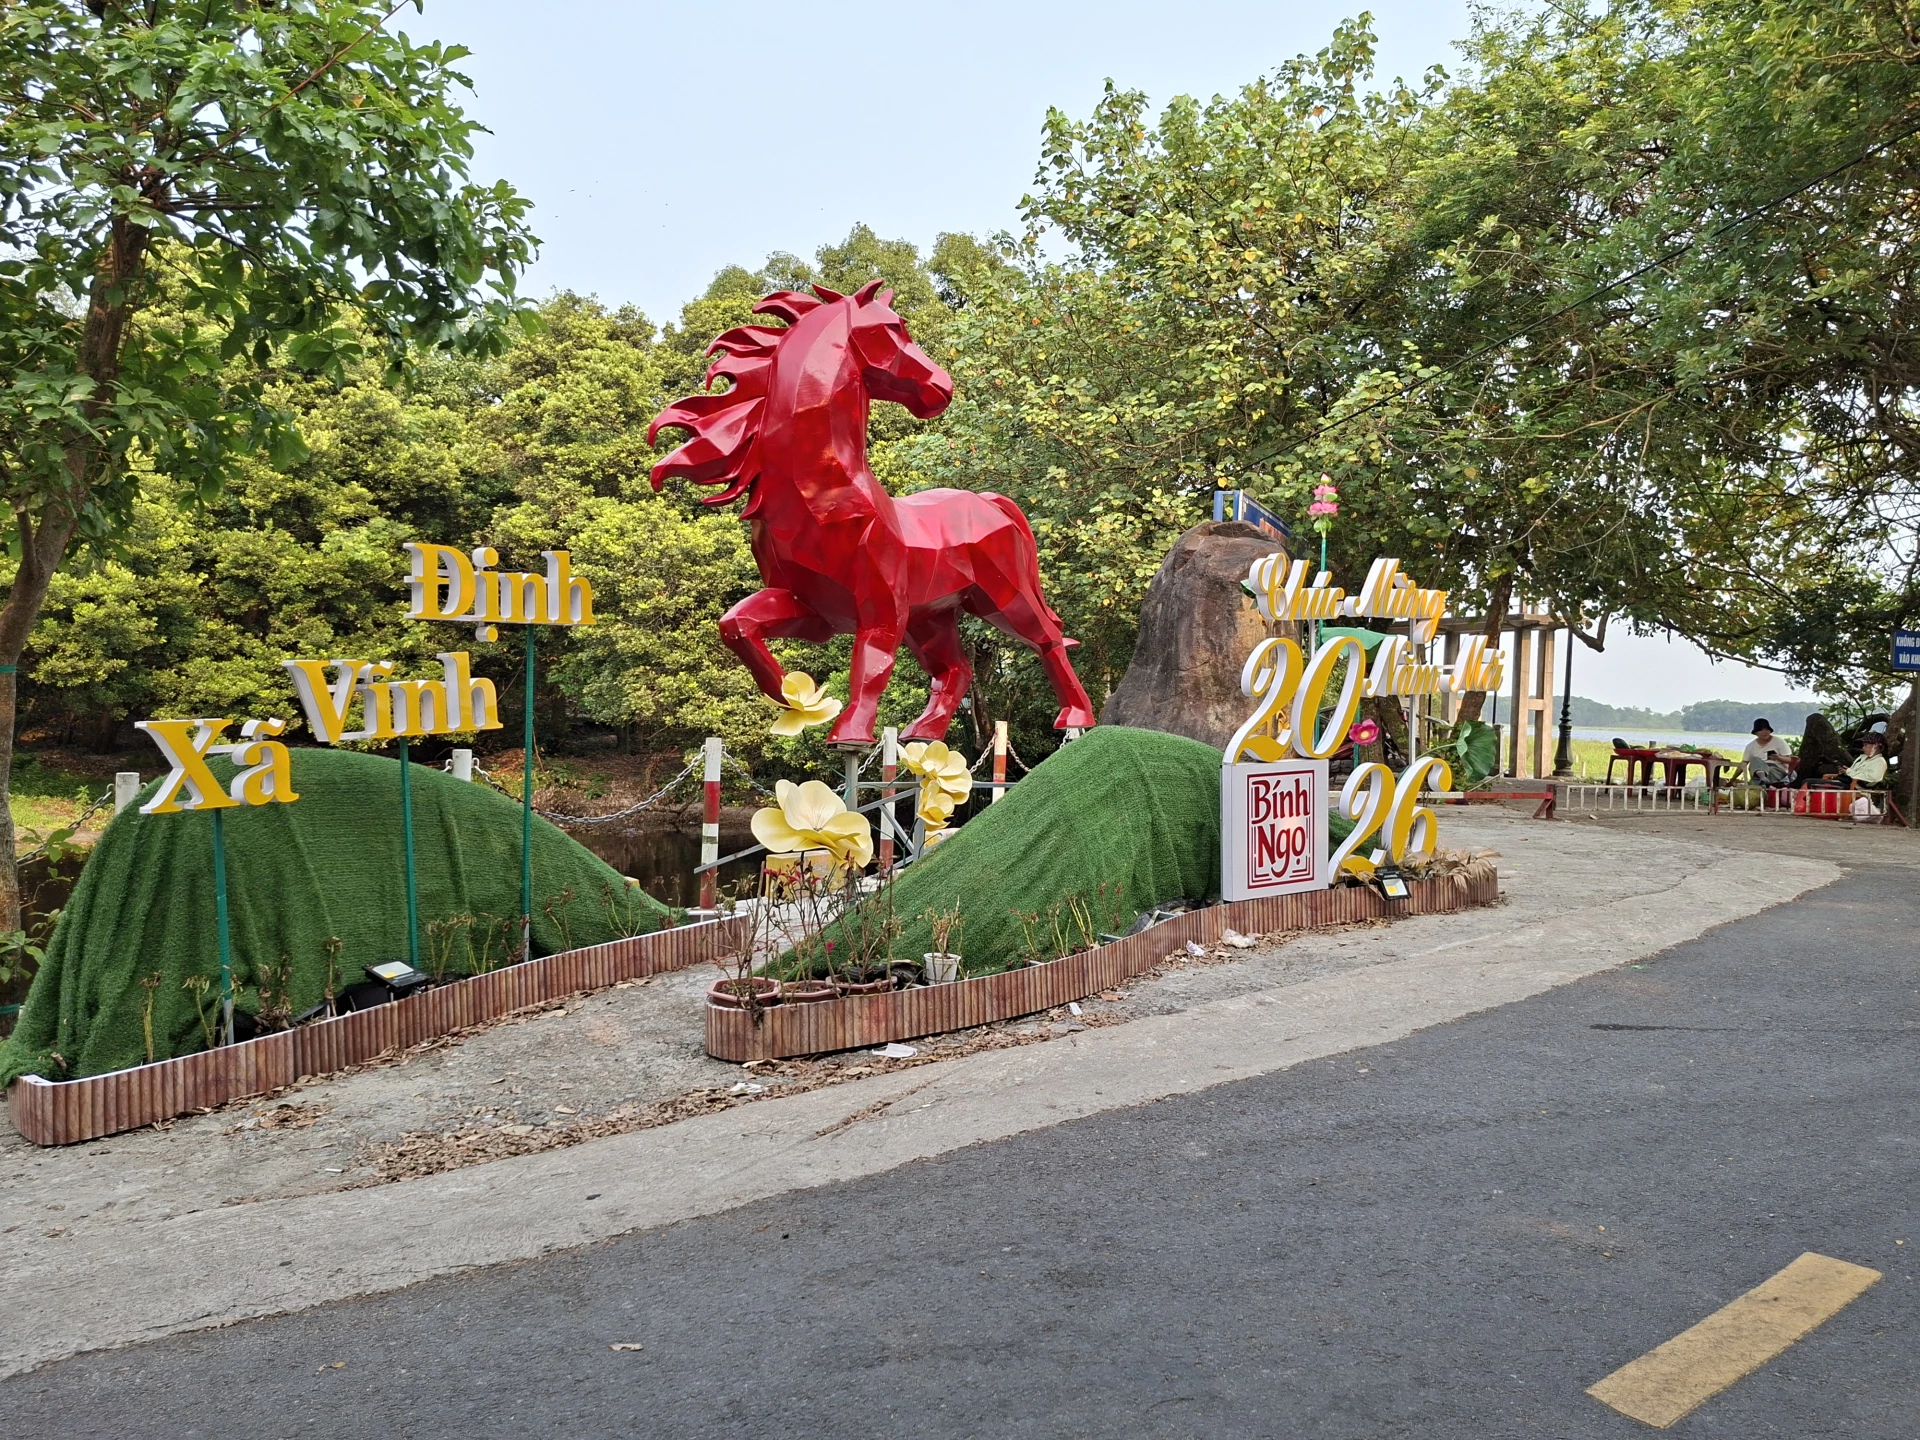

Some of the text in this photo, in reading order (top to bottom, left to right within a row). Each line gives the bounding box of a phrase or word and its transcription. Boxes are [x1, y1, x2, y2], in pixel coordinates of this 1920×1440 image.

[403, 542, 597, 643] Định
[1248, 552, 1447, 645] Chúc Mừng
[1360, 634, 1506, 698] Năm Mới
[1896, 634, 1915, 648] KHÔNG
[1899, 651, 1910, 664] VÀO
[282, 651, 504, 743] Vĩnh
[1222, 636, 1366, 765] 20
[134, 717, 300, 815] Xã
[1251, 777, 1310, 825] Bính
[1257, 823, 1306, 878] Ngọ
[1328, 756, 1452, 884] 26
